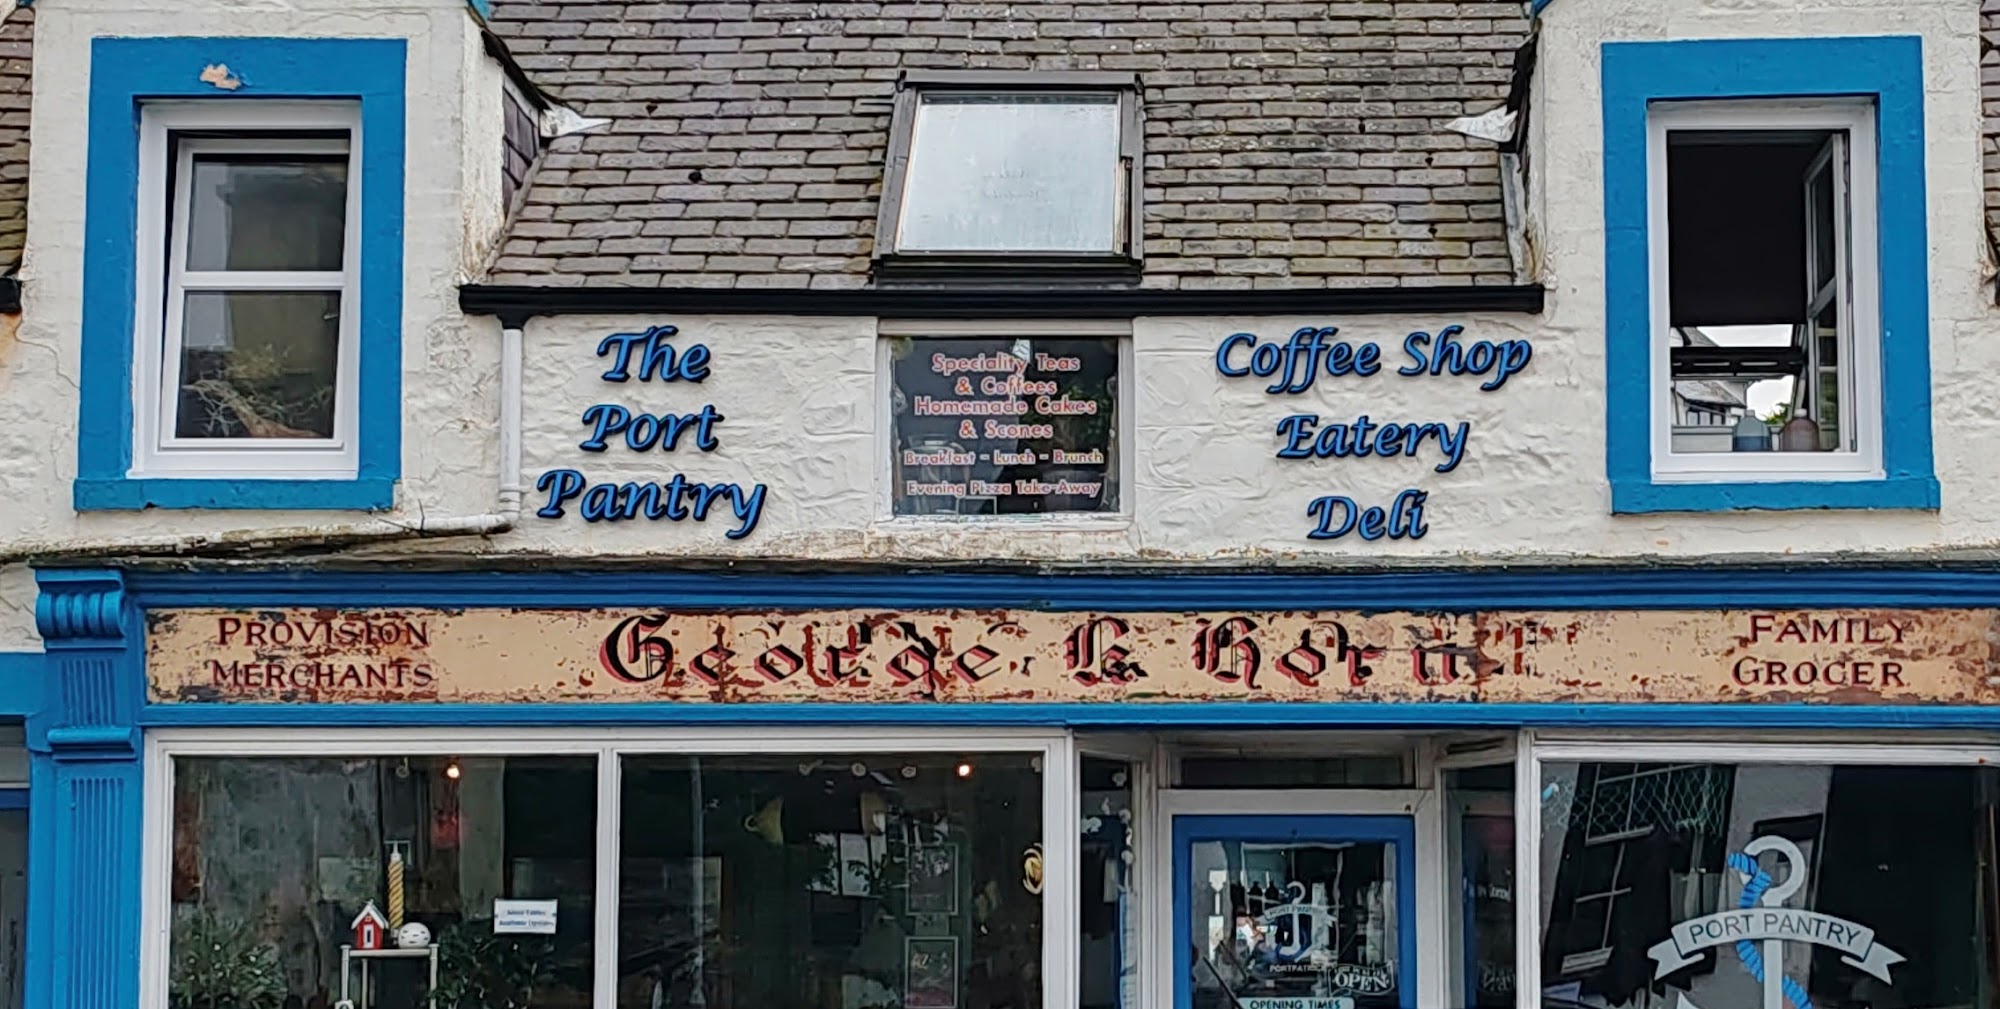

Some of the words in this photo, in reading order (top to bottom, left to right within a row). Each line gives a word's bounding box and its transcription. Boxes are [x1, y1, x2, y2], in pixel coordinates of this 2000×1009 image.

[597, 325, 711, 383] The
[932, 352, 1028, 376] Speciality
[1035, 353, 1081, 372] Teas
[1215, 326, 1382, 394] Coffee
[1398, 325, 1533, 391] Shop
[955, 377, 974, 395] &
[981, 376, 1057, 395] Coffees
[914, 395, 1029, 415] Homemade
[1035, 394, 1097, 414] Cakes
[579, 403, 725, 452] Port
[959, 420, 978, 439] &
[985, 420, 1053, 438] Scones
[904, 450, 976, 465] Breakfast
[993, 450, 1036, 465] Lunch
[1052, 449, 1104, 464] Brunch
[1276, 414, 1470, 473] Eatery
[906, 480, 966, 497] Evening
[970, 480, 1012, 495] Pizza
[1015, 479, 1101, 498] Take-Away
[537, 468, 768, 540] Pantry
[1306, 489, 1429, 541] Deli
[217, 617, 431, 648] PROVISION
[1750, 614, 1907, 644] FAMILY
[209, 659, 434, 689] MERCHANTS
[1732, 656, 1905, 687] GROCER
[1689, 913, 1754, 945] PORT
[1763, 912, 1861, 946] PANTRY
[1334, 970, 1388, 991] OPEN
[1249, 1000, 1303, 1009] OPENING
[1309, 1000, 1341, 1009] TIMES
